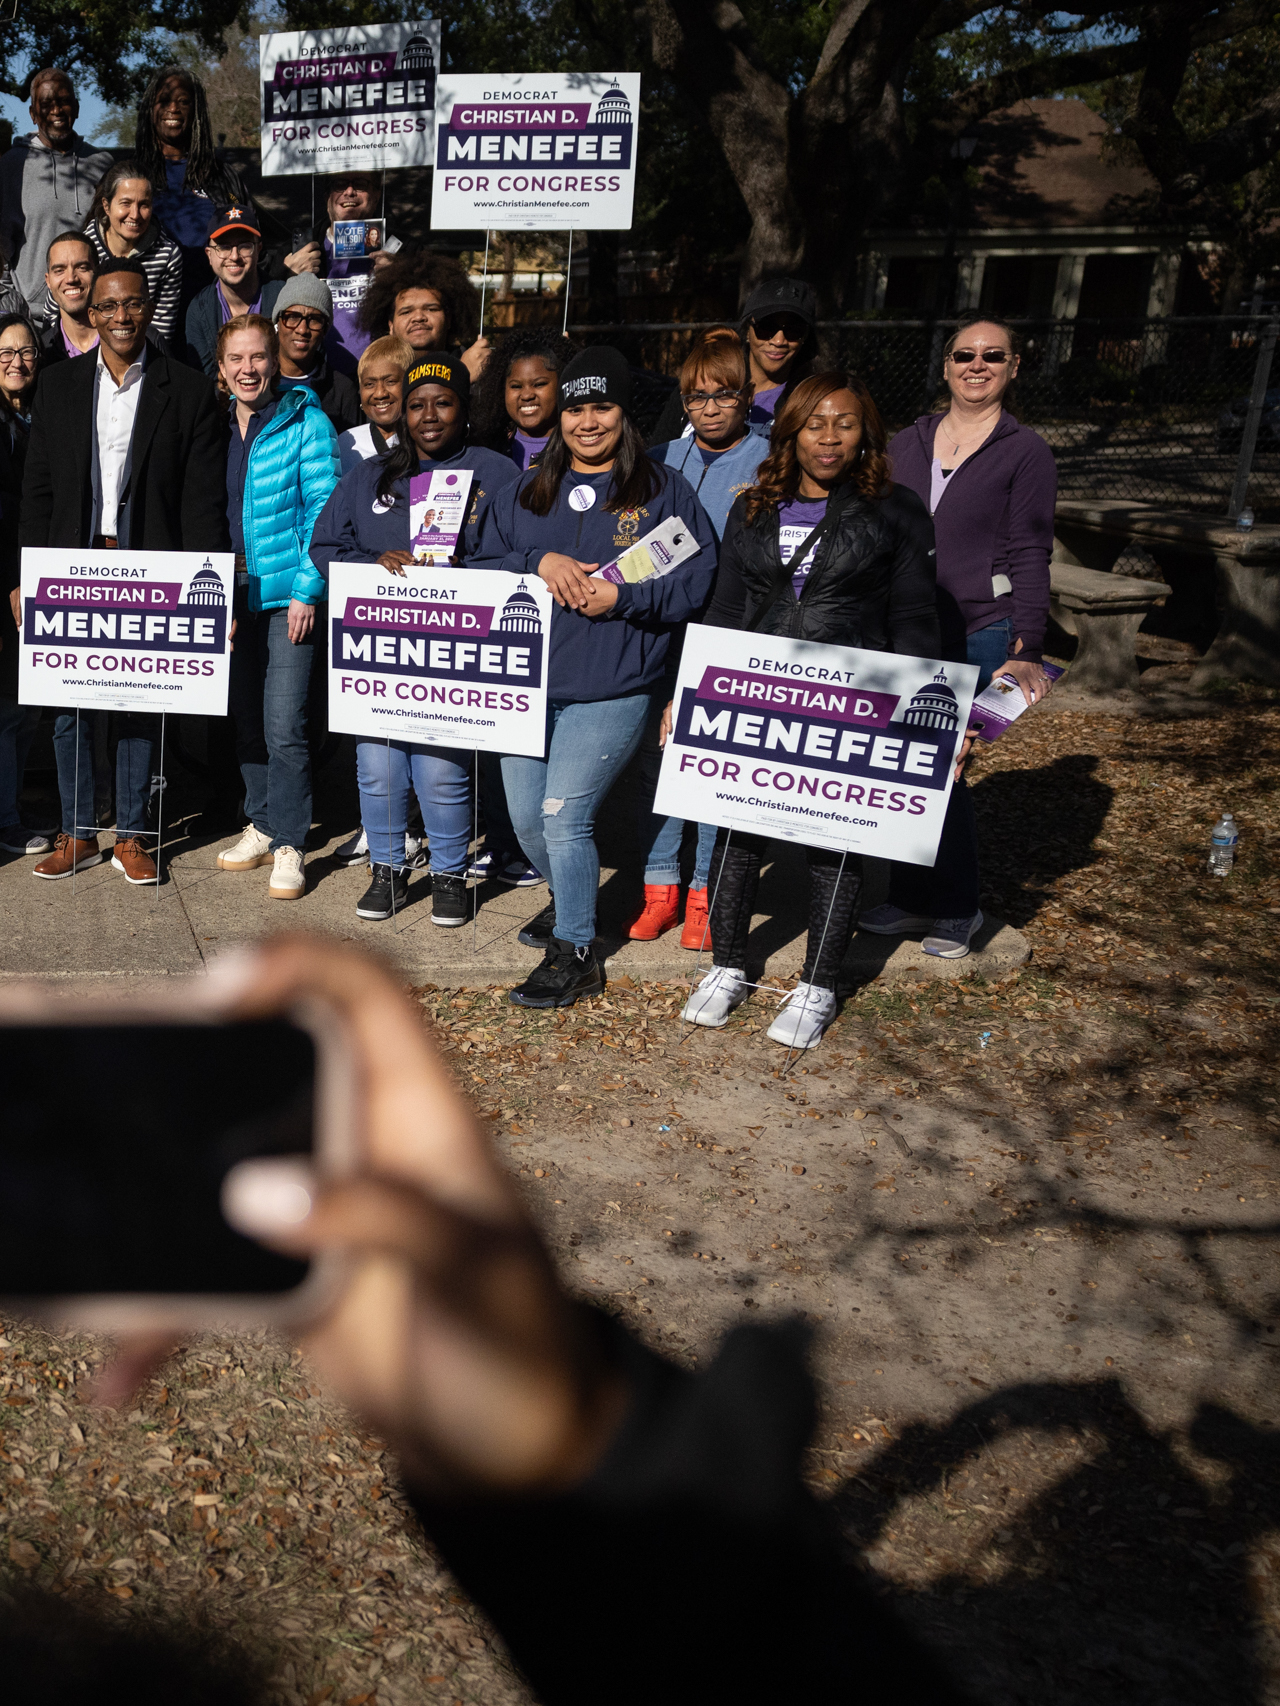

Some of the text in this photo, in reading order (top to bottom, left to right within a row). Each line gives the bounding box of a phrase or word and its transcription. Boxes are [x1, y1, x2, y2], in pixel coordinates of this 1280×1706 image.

[301, 43, 367, 56] DEMOCRAT
[283, 59, 386, 79] CHRISTIAN D.
[273, 79, 426, 114] MENEFEE
[483, 91, 558, 100] DEMOCRAT
[461, 110, 578, 124] CHRISTIAN D.
[273, 117, 426, 142] FOR CONGRESS
[298, 142, 399, 154] www.ChristianMenefee.com
[448, 136, 621, 160] MENEFEE
[445, 176, 620, 192] FOR CONGRESS
[337, 227, 363, 235] VOTE
[337, 235, 363, 244] WILSON
[408, 363, 451, 384] TEAMSTERS
[562, 376, 607, 400] TEAMSTERS
[574, 389, 590, 397] DRIVE
[70, 566, 147, 578] DEMOCRAT
[47, 585, 169, 603] CHRISTIAN D.
[377, 585, 457, 600] DEMOCRAT
[35, 611, 215, 644] MENEFEE
[354, 605, 481, 629] CHRISTIAN D.
[33, 652, 214, 676] FOR CONGRESS
[343, 633, 530, 676] MENEFEE
[748, 657, 854, 683] DEMOCRAT
[62, 679, 182, 691] www.ChristianMenefee.com
[342, 677, 529, 712] FOR CONGRESS
[714, 677, 878, 718] CHRISTIAN D.
[371, 708, 495, 727] www.ChristianMenefee.com
[689, 705, 938, 777] MENEFEE
[679, 754, 927, 816] FOR CONGRESS
[716, 792, 878, 828] www.ChristianMenefee.com
